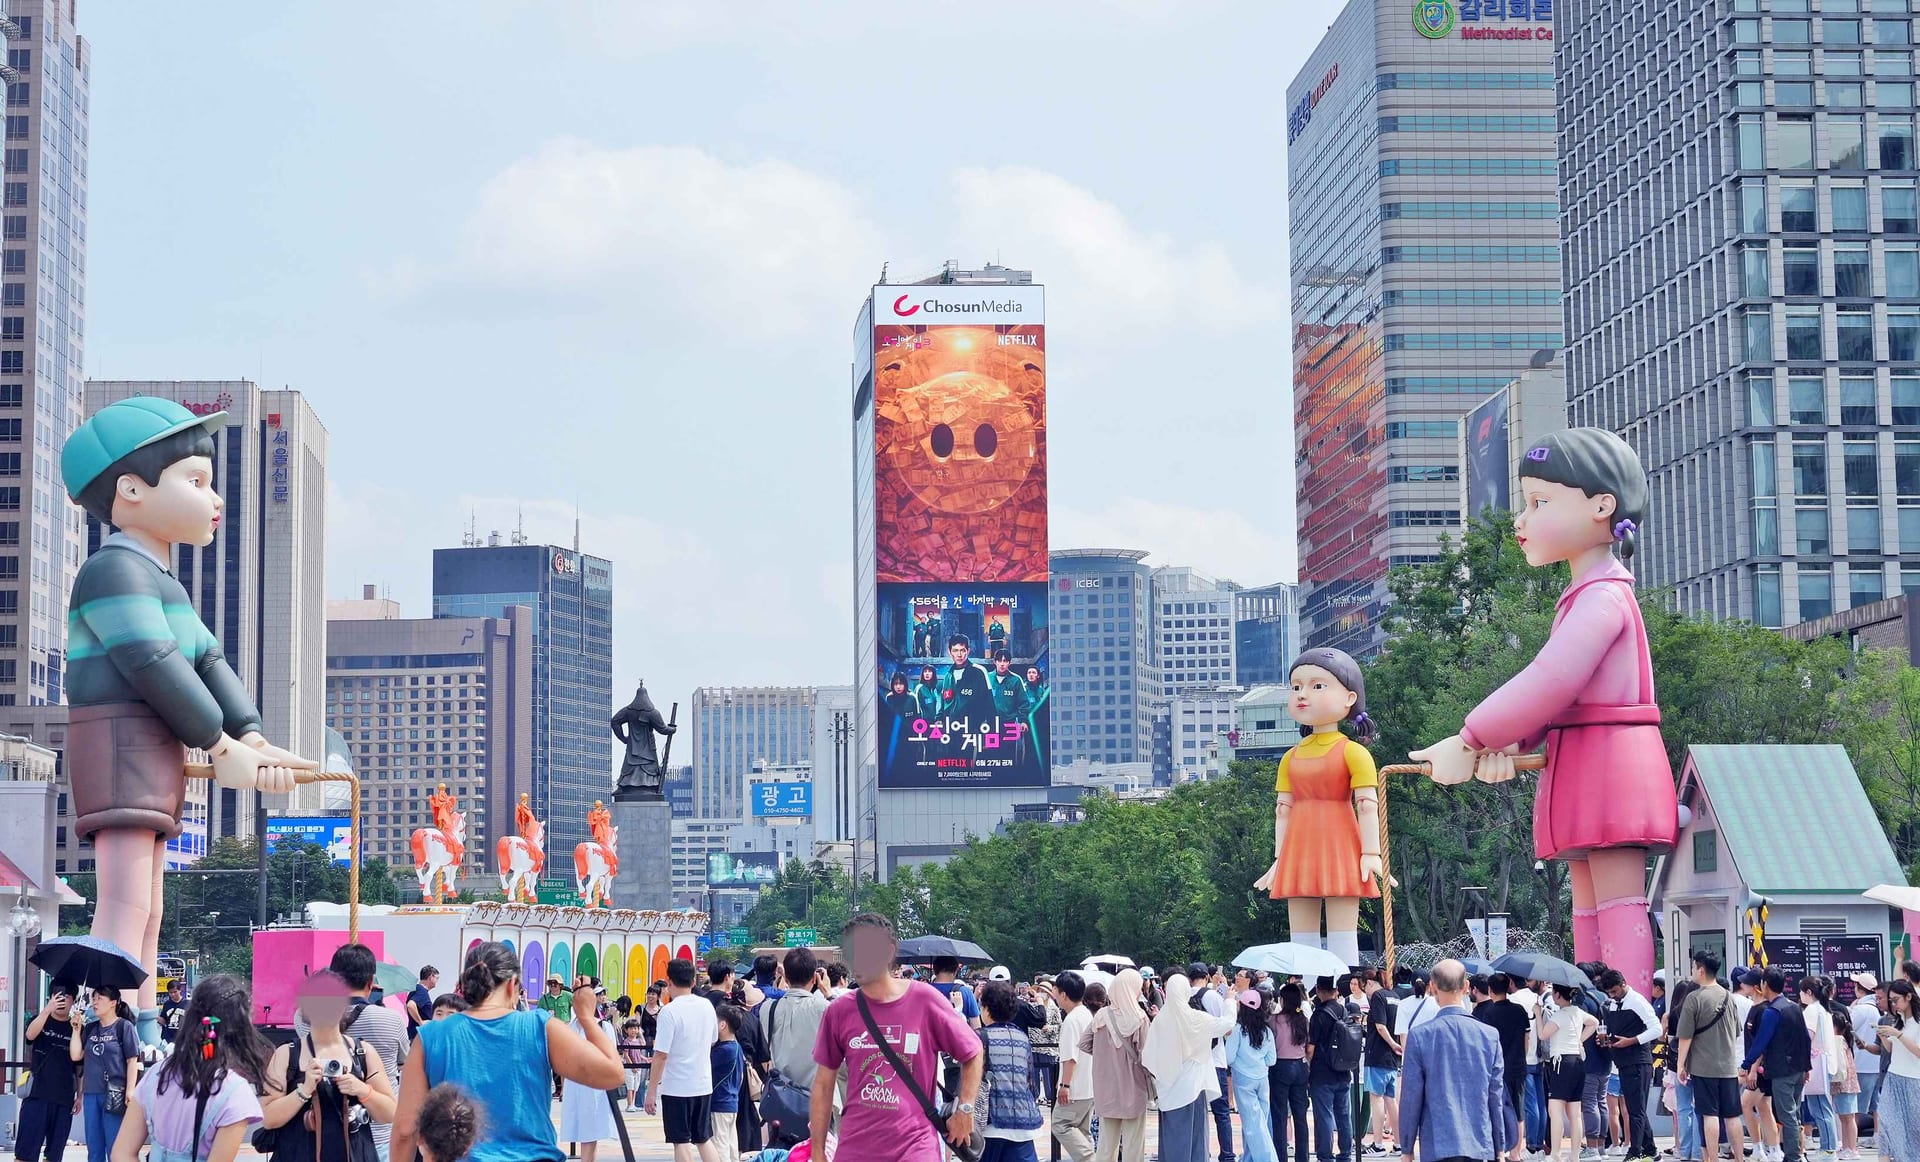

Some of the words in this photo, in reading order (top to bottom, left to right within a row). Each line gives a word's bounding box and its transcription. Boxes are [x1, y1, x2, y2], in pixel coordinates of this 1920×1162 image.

[1461, 26, 1532, 41] Methodist
[923, 299, 1023, 313] ChosunMedia
[998, 334, 1038, 346] NETFLIX
[271, 430, 288, 503] 서울신문
[1076, 579, 1099, 588] ICBC
[967, 594, 995, 609] 마지막
[908, 716, 968, 744] 오징어
[961, 716, 1000, 753] 게임
[937, 759, 967, 768] NETFLIX
[787, 930, 813, 938] 종로1가
[861, 1086, 900, 1104] CANARIA
[865, 1082, 893, 1095] GRAN
